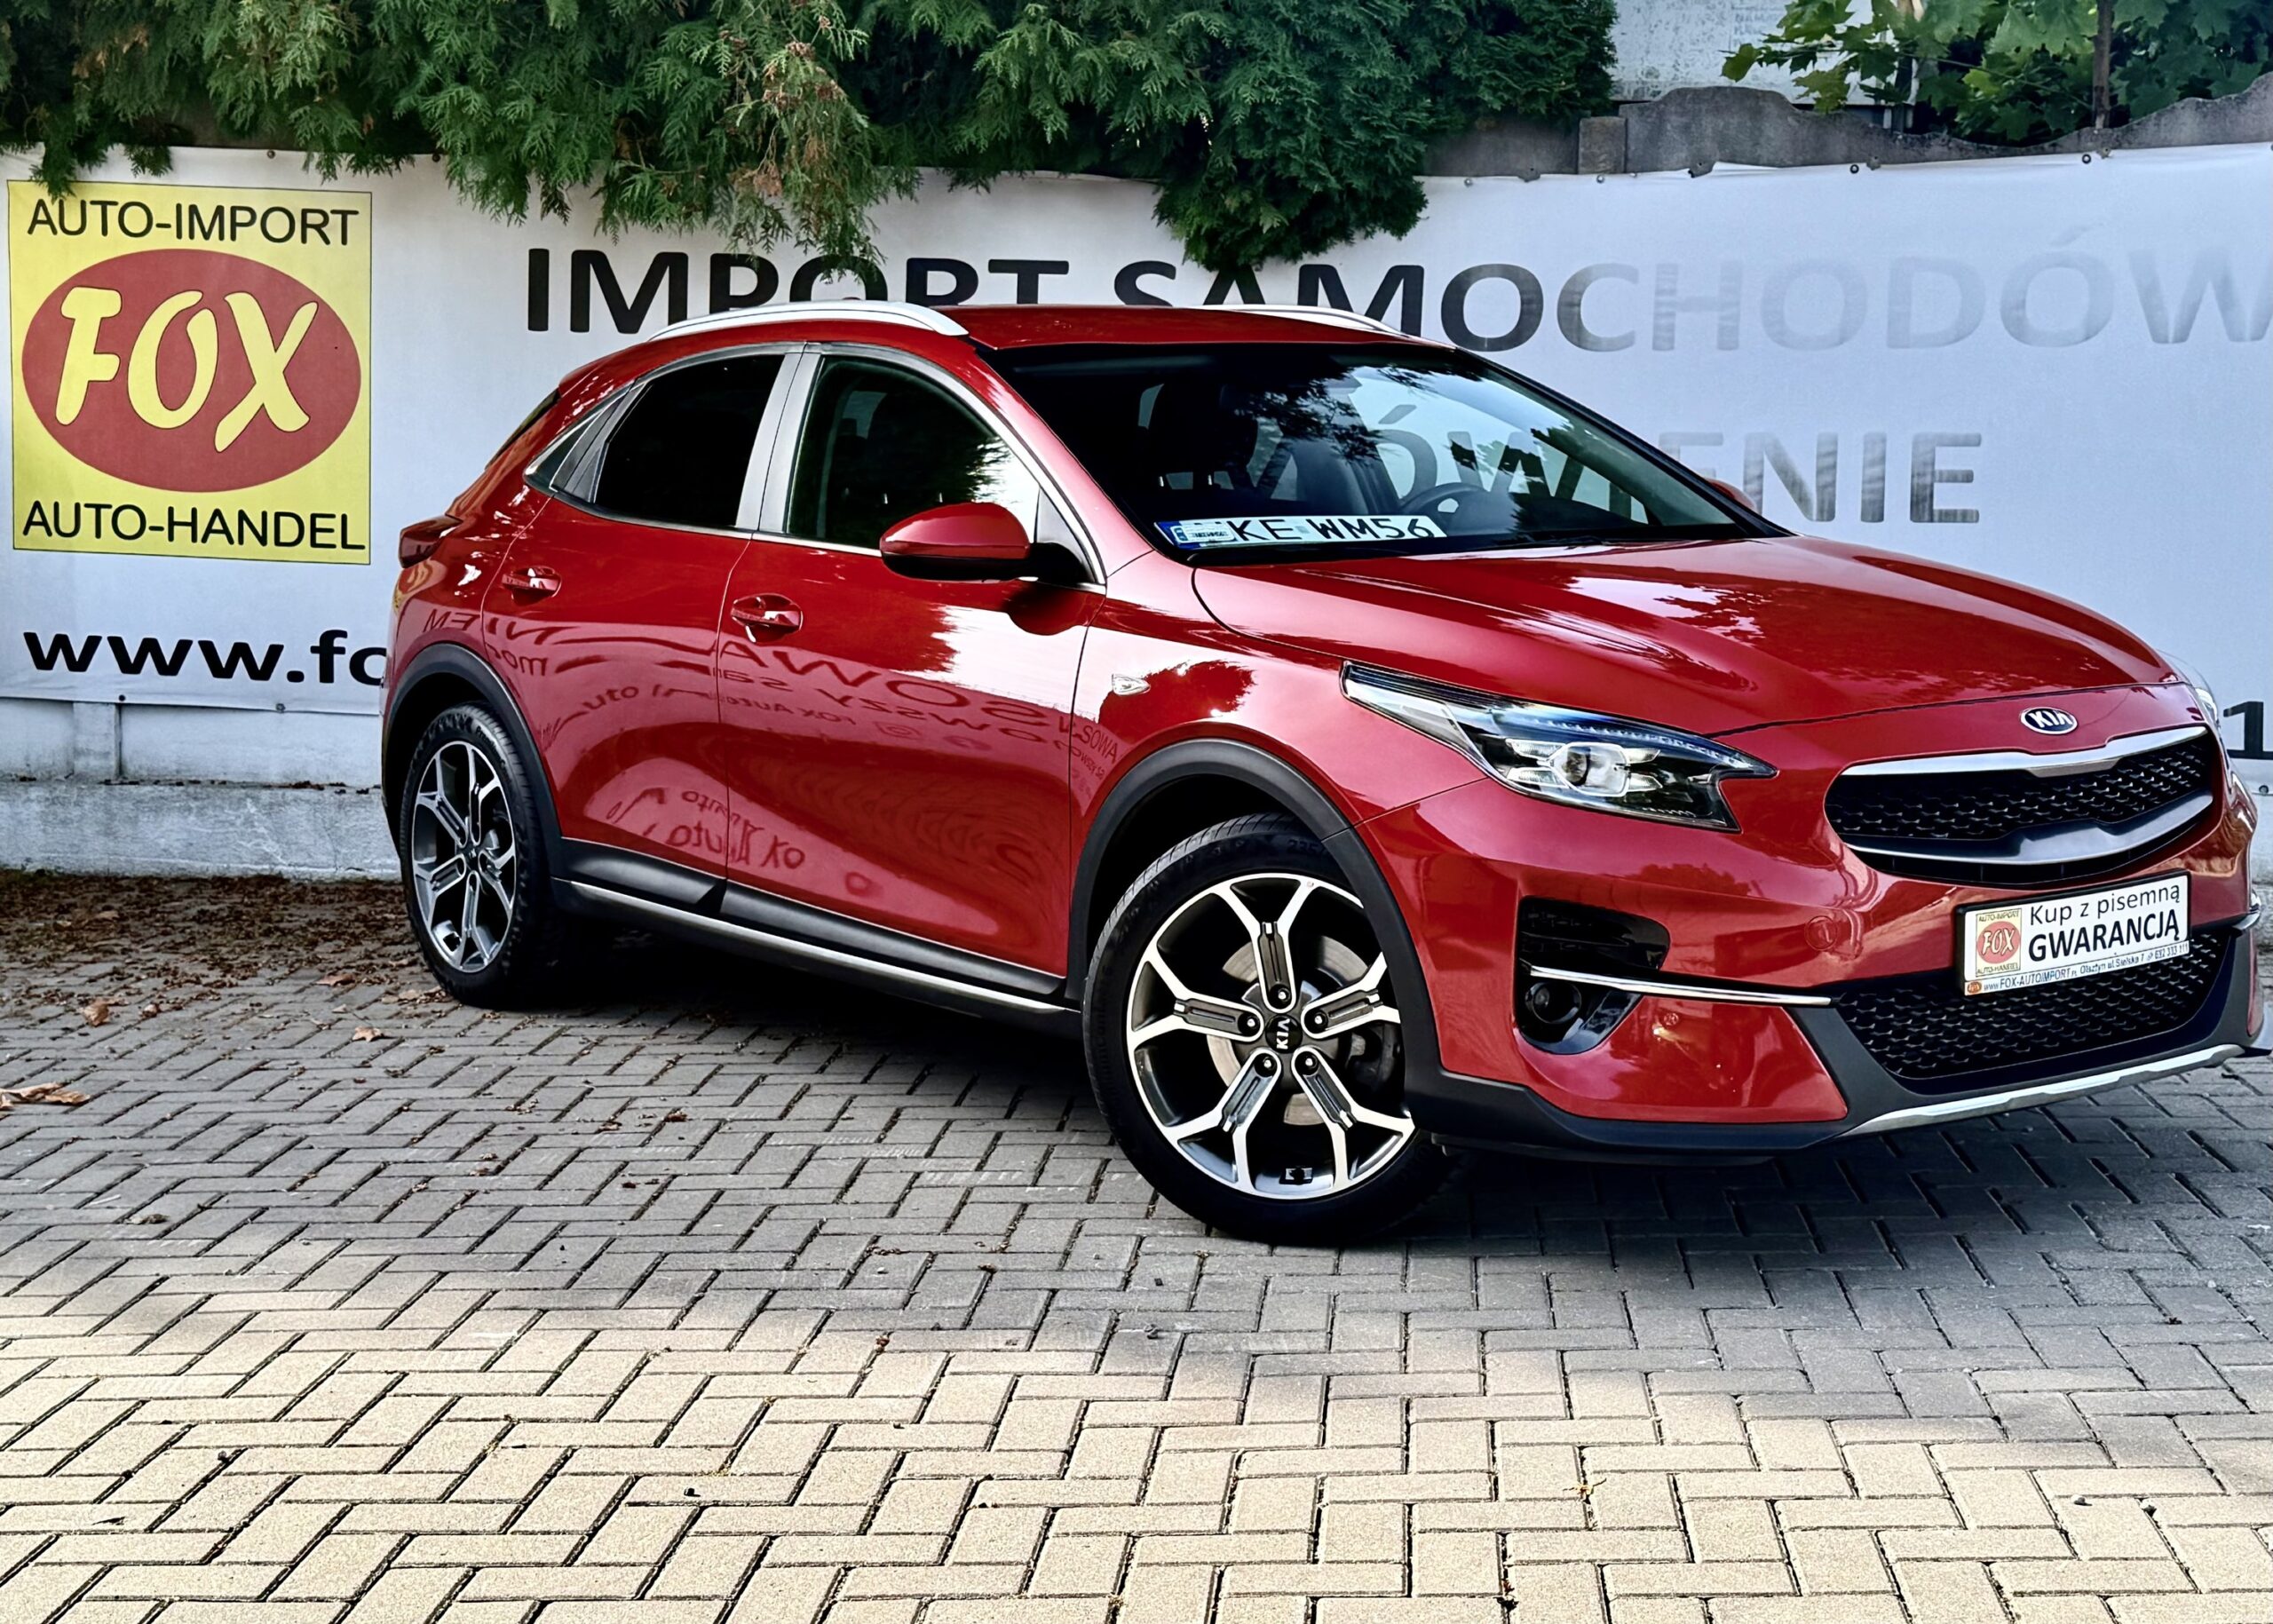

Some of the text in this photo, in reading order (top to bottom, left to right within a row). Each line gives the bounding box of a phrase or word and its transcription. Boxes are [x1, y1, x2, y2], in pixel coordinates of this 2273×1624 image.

[28, 198, 360, 246] AUTO-IMPORT
[55, 286, 320, 454] FOX
[23, 500, 365, 551] AUTO-HANDEL
[1306, 518, 1435, 539] WM56
[2027, 709, 2073, 729] KIA
[2031, 884, 2181, 926] Kup z pisemną
[1981, 927, 2016, 956] FOX
[2028, 908, 2181, 963] GWARANCJĄ
[1276, 1018, 1291, 1050] KIA
